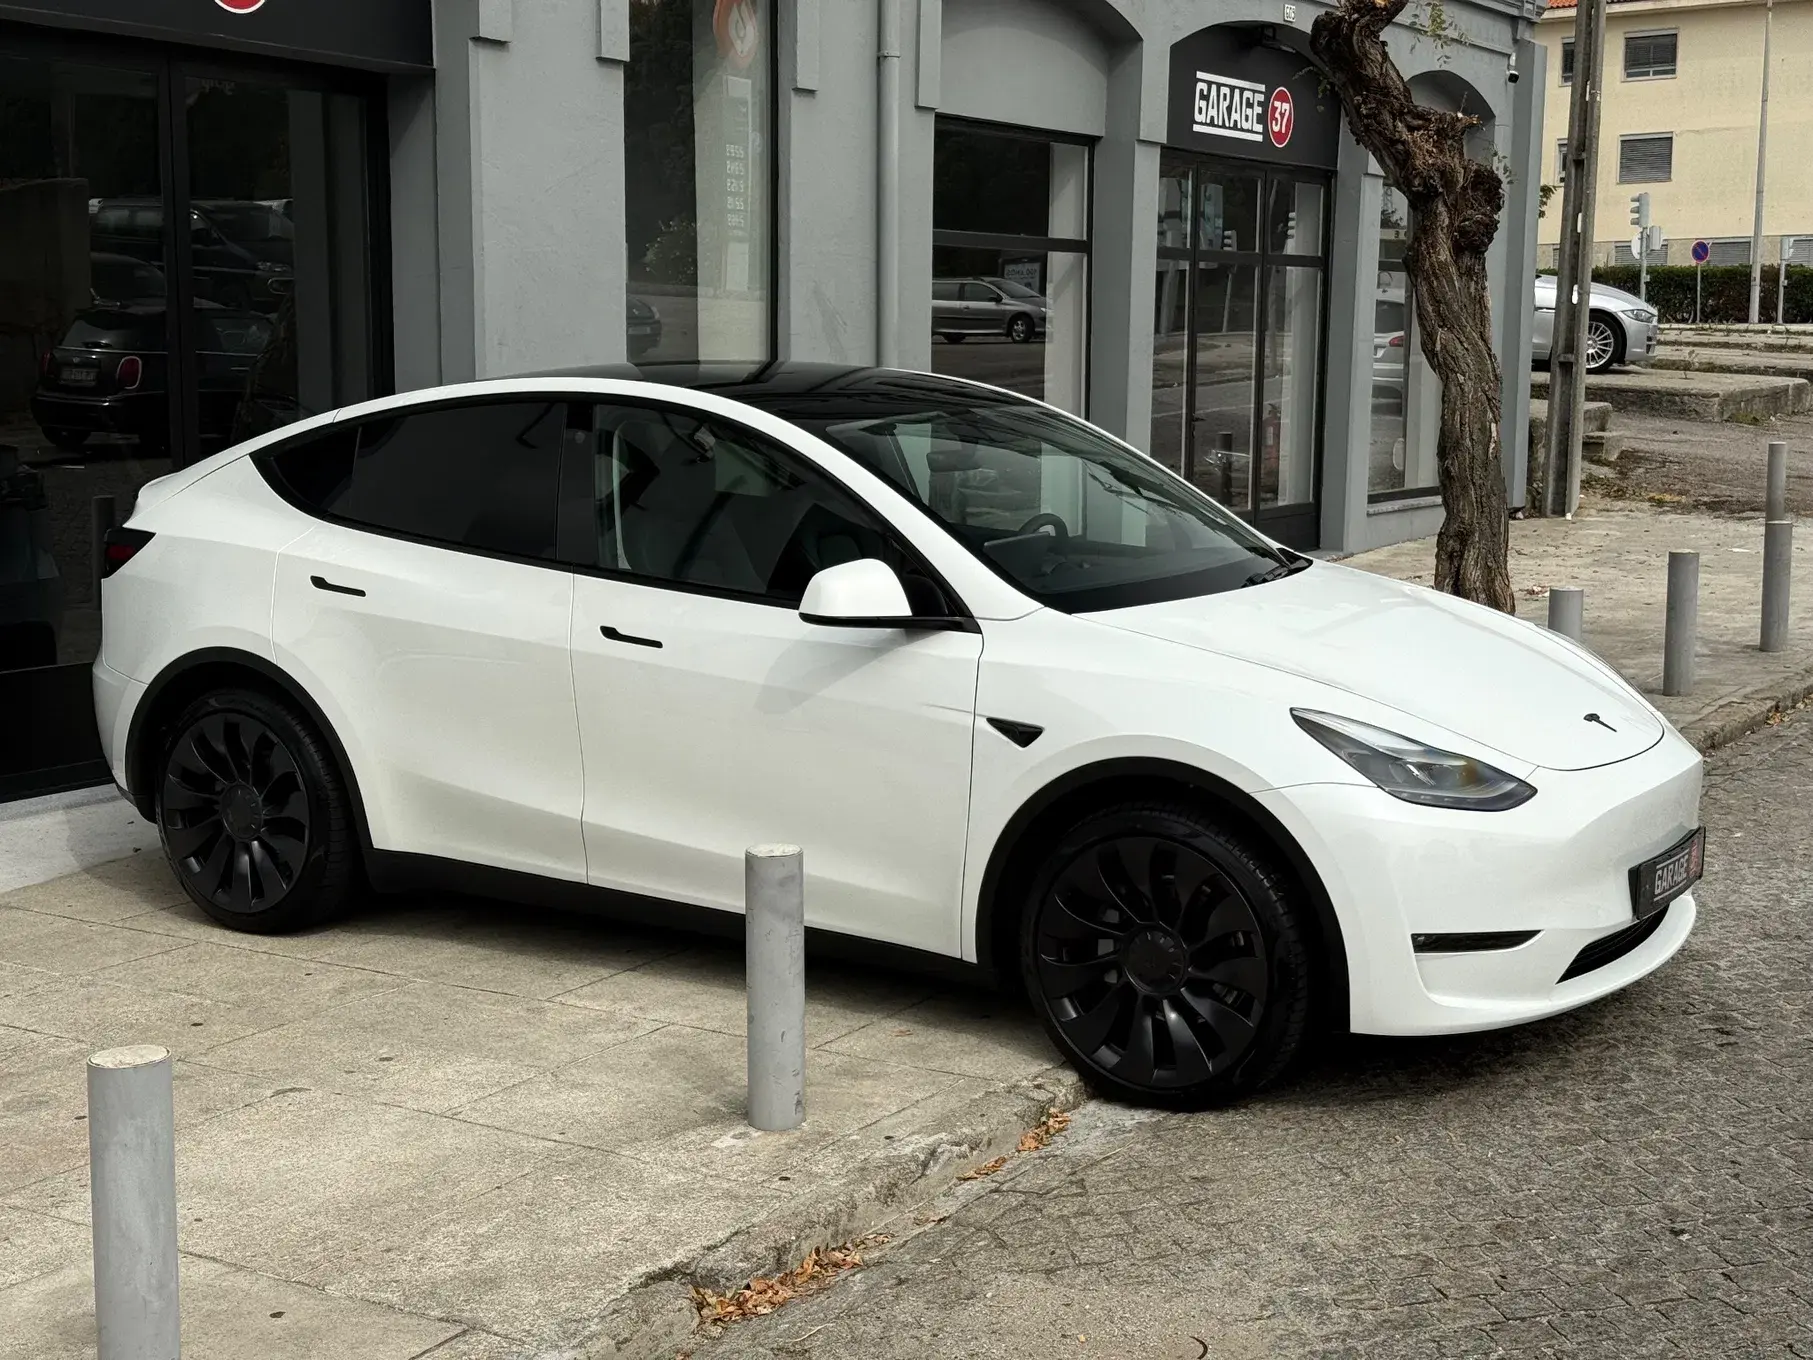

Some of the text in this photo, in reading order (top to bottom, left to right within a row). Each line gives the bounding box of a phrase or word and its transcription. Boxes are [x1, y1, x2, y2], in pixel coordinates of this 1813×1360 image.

[1194, 81, 1291, 134] GARAGE 37
[1654, 854, 1689, 895] GARAGE
